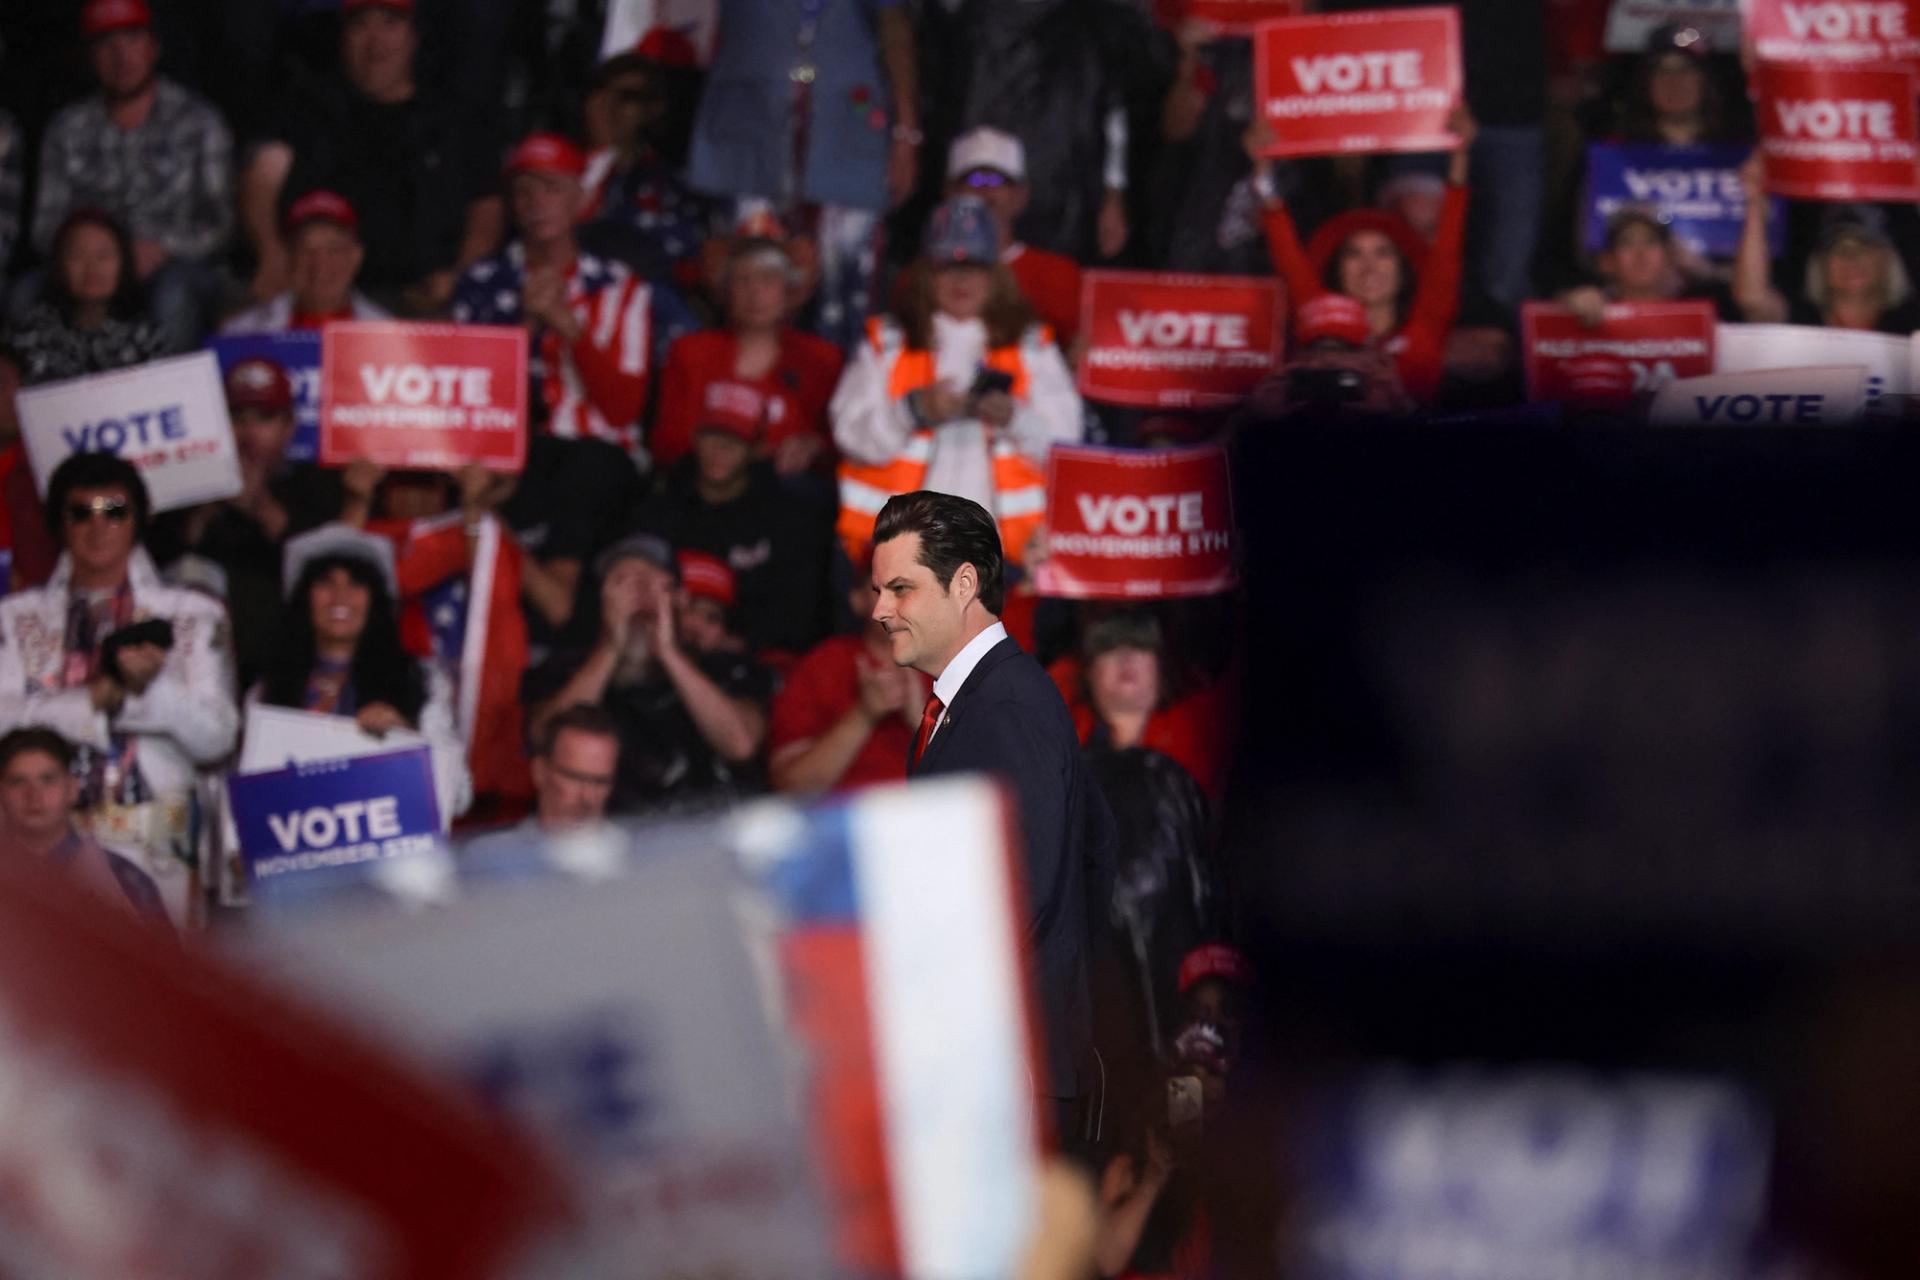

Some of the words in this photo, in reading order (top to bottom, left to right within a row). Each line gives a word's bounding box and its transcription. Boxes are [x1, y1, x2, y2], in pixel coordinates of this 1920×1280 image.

[1783, 2, 1906, 39] VOTE
[1292, 50, 1421, 93] VOTE
[1775, 100, 1894, 139] VOTE
[1624, 168, 1743, 199] VOTE
[1117, 310, 1248, 347] VOTE
[360, 363, 491, 405] VOTE
[1696, 395, 1824, 423] VOTE
[63, 406, 187, 454] VOTE
[1077, 492, 1204, 534] VOTE
[1050, 531, 1183, 558] NOVEMBER
[268, 795, 402, 852] VOTE
[255, 842, 379, 879] NOVEMBER
